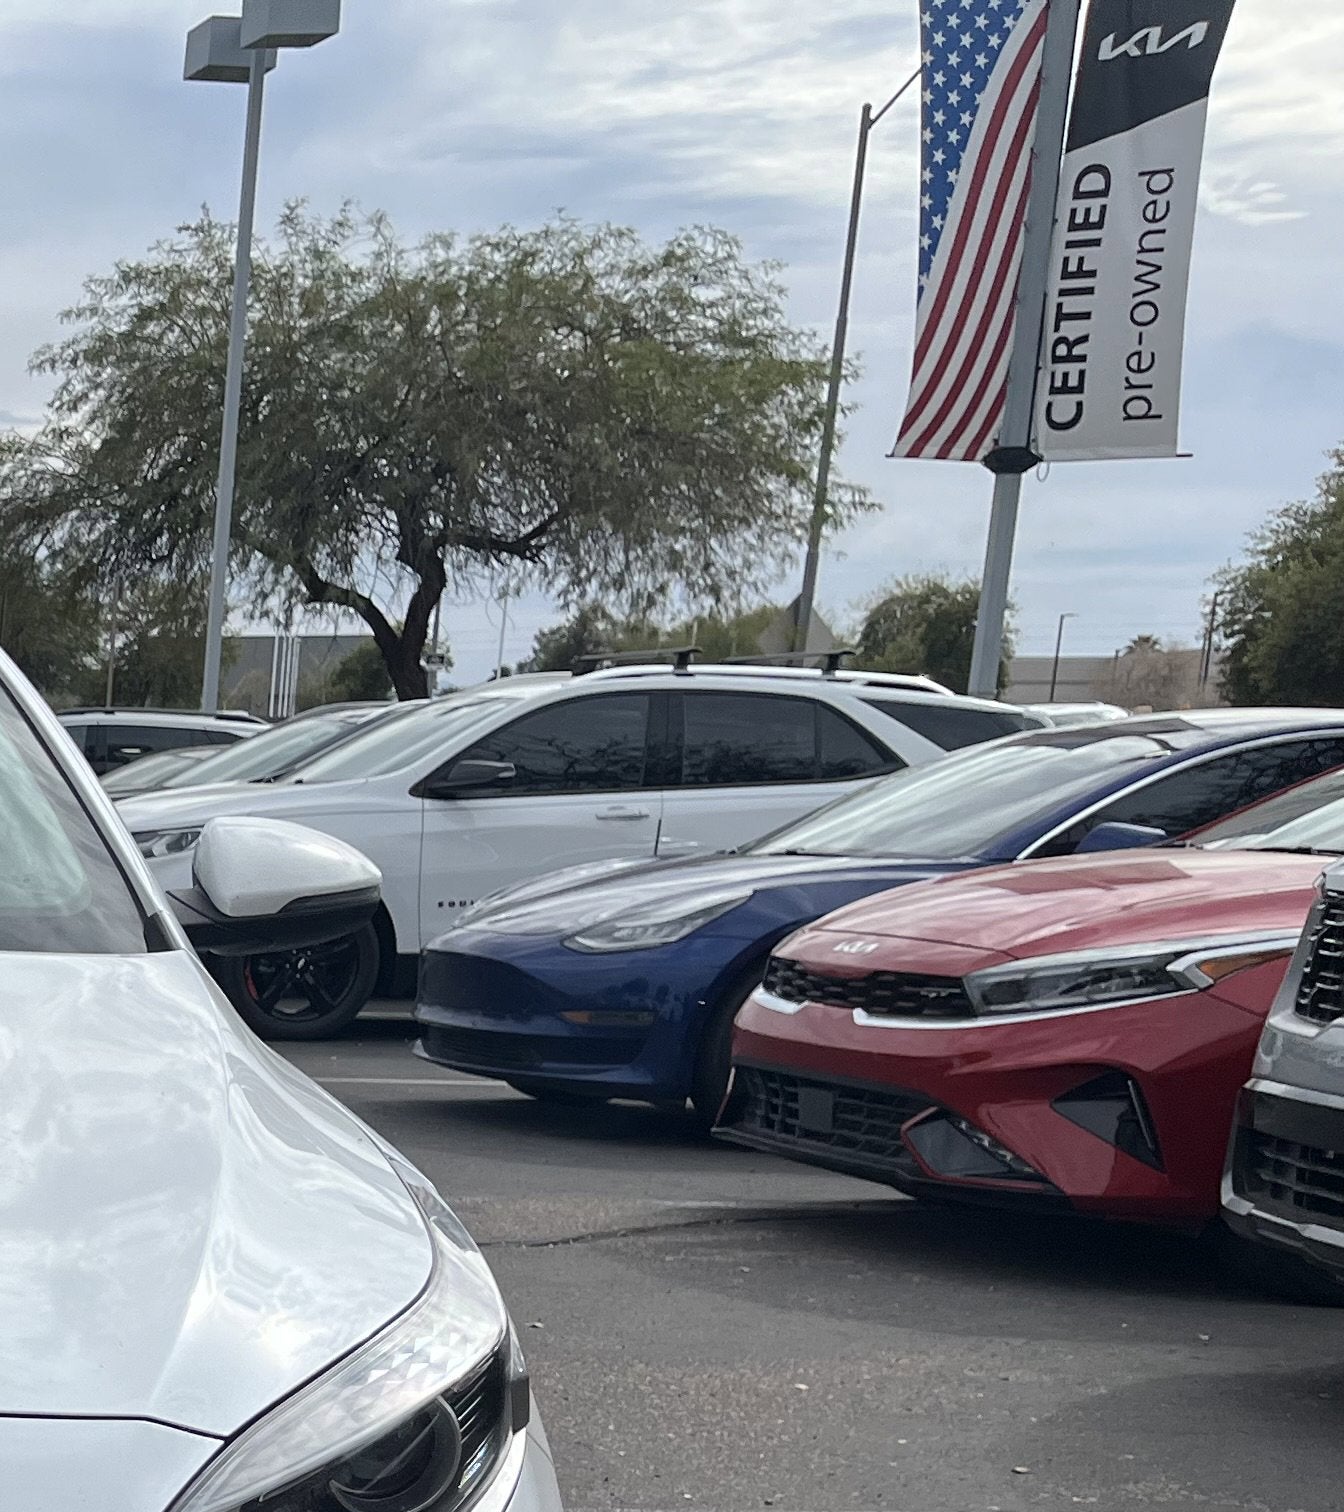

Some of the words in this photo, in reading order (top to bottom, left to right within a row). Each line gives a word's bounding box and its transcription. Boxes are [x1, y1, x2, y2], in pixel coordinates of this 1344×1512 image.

[1098, 21, 1210, 61] KIA
[1045, 163, 1112, 431] CERTIFIED
[1123, 167, 1176, 422] pre-owned
